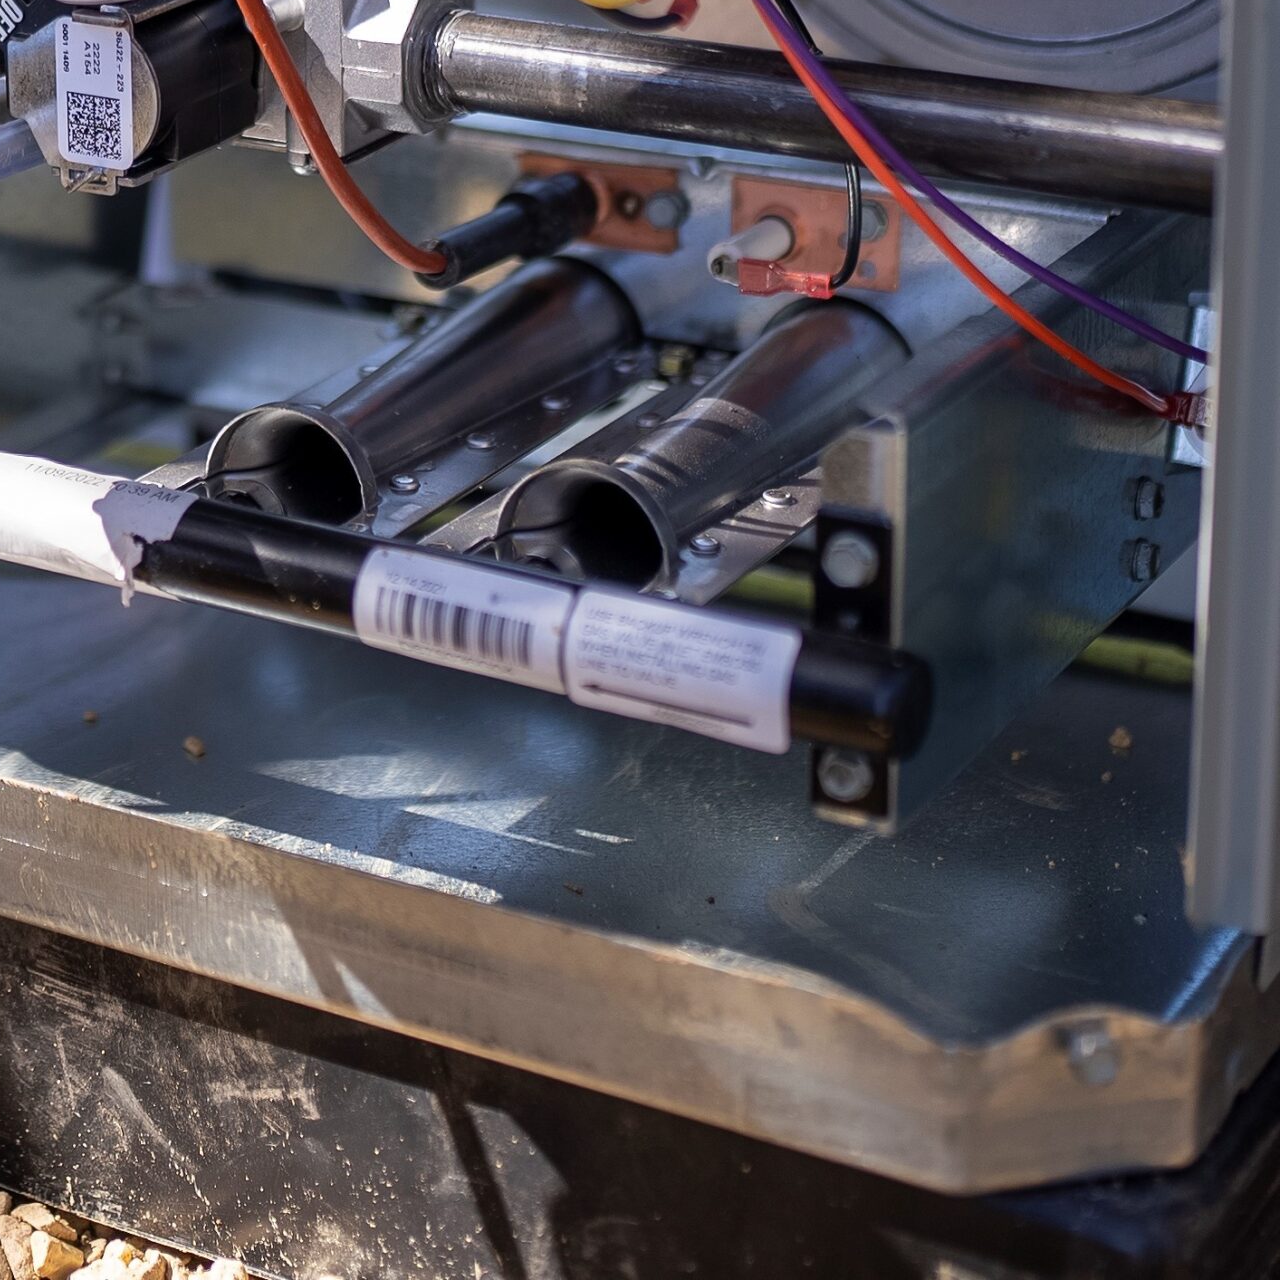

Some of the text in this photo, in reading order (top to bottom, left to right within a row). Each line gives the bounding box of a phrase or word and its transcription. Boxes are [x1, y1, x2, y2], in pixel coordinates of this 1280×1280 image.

[93, 42, 101, 75] 2222
[25, 463, 106, 487] 11/09/2022
[148, 490, 180, 503] AM
